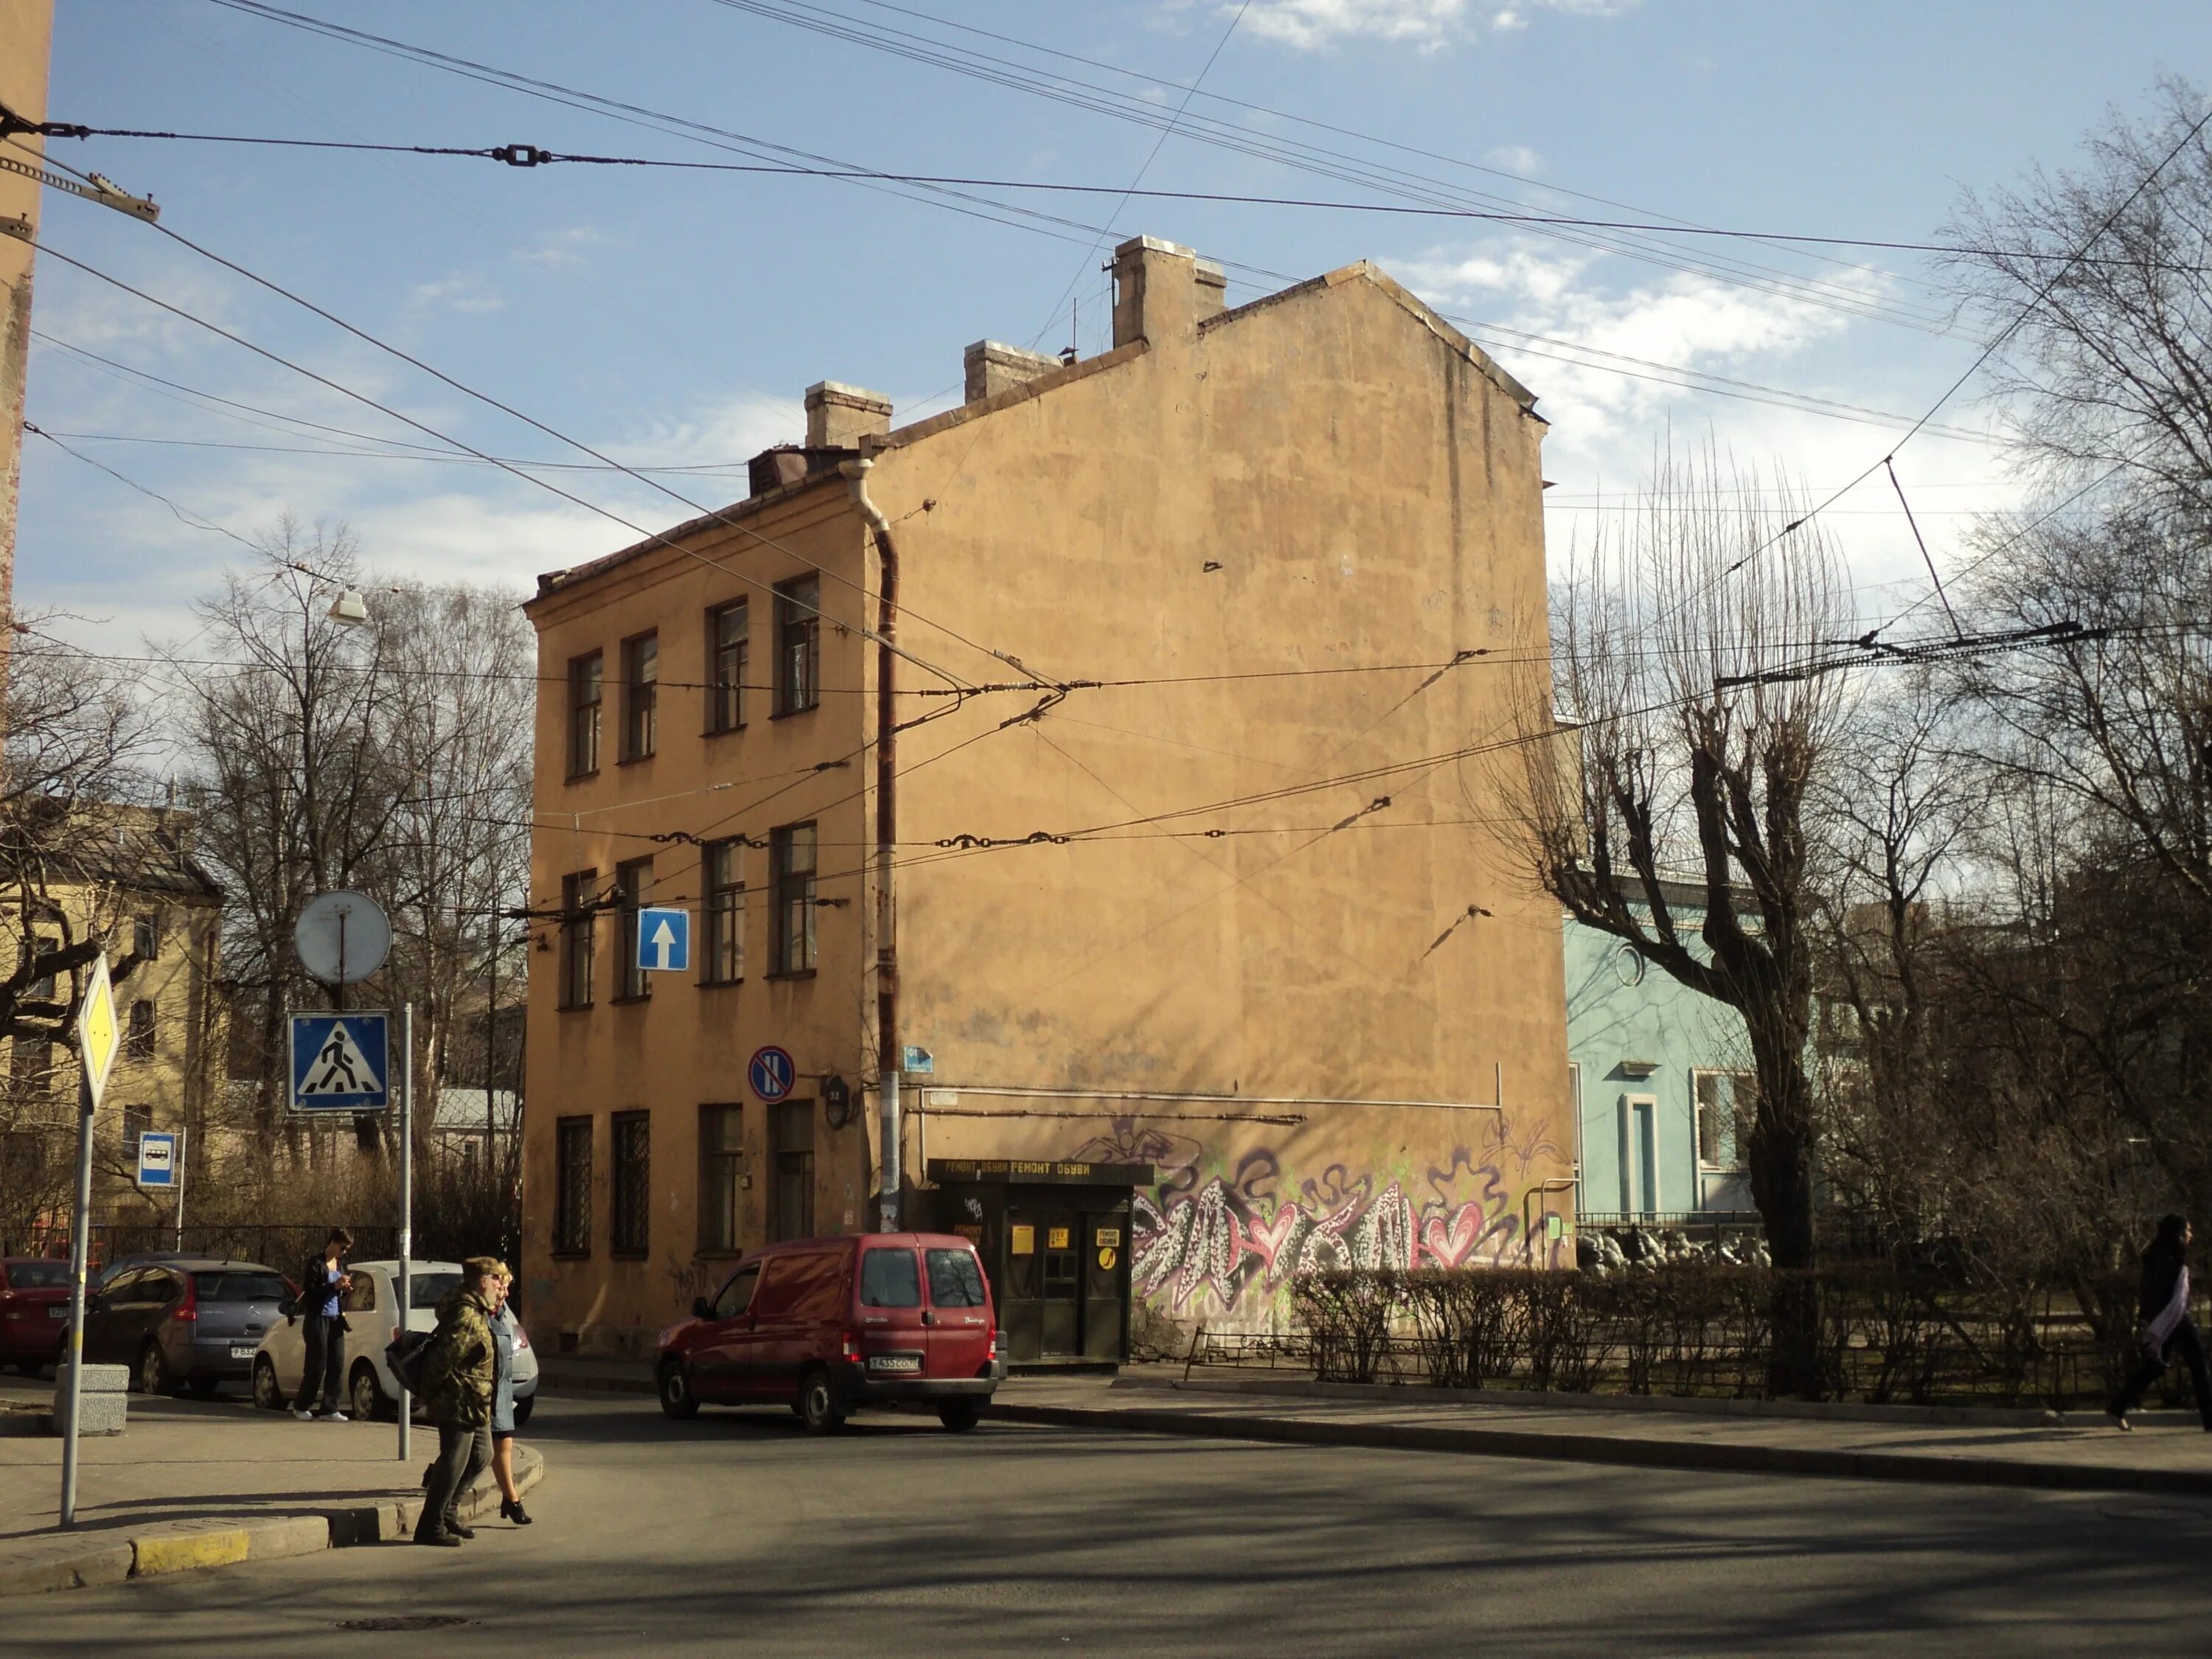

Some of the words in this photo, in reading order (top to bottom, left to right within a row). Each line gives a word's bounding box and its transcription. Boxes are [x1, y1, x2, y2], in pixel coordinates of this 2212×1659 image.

[945, 1161, 975, 1172] РЕМОНТ
[981, 1162, 1009, 1172] ОБУВИ
[1011, 1162, 1050, 1174] РЕМОНТ
[1057, 1164, 1090, 1175] ОБУВИ
